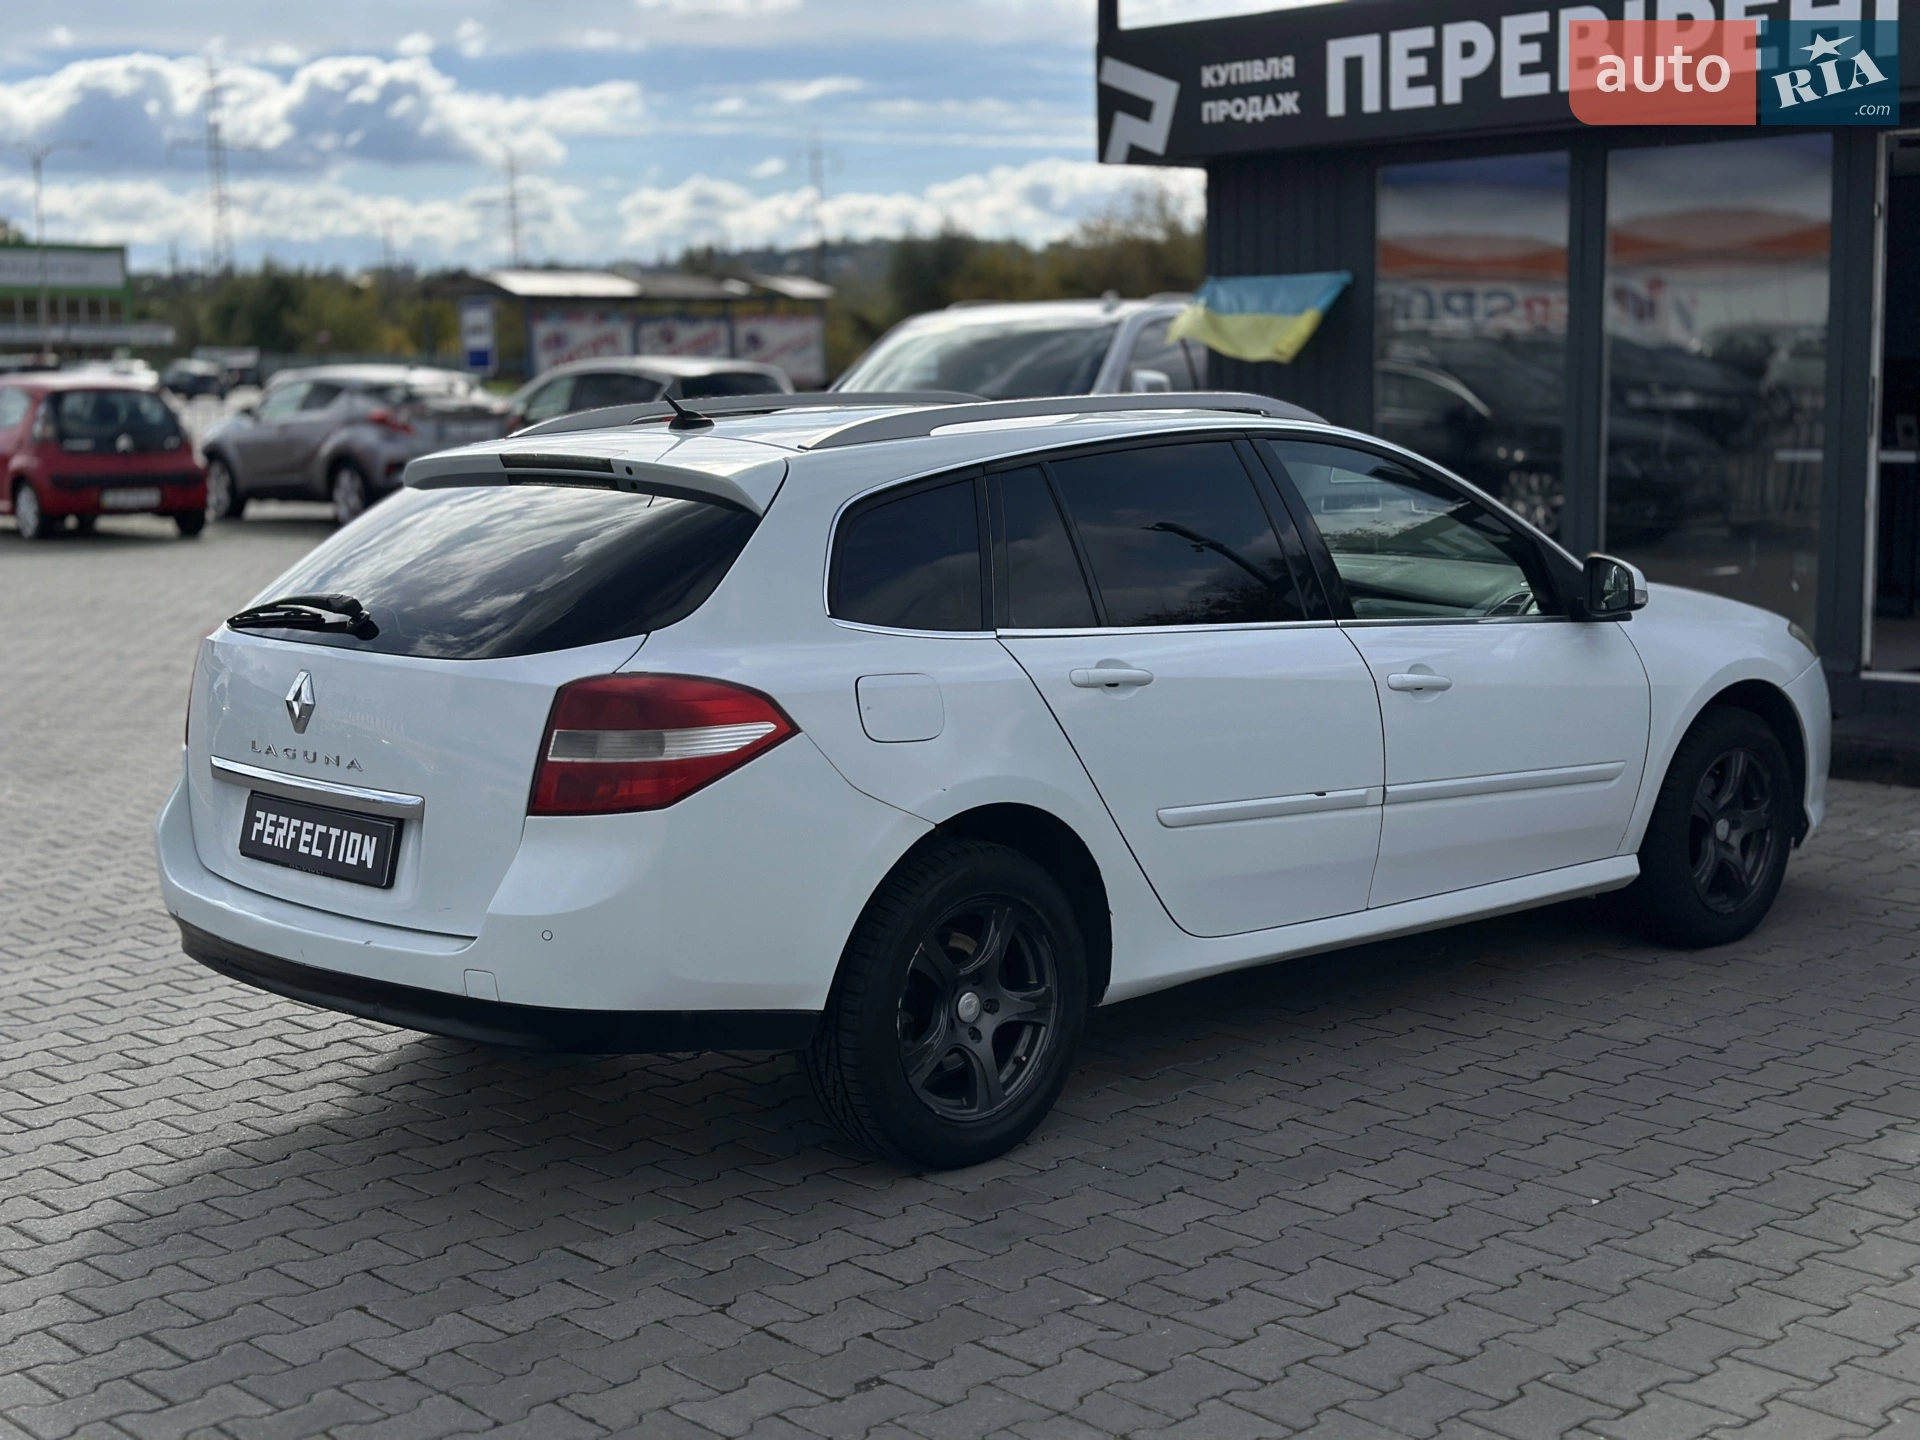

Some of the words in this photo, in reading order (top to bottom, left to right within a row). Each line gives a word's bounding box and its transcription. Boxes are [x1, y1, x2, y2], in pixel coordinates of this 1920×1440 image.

[1200, 54, 1295, 88] КУПІВЛЯ
[1201, 91, 1300, 124] ПРОДАЖ
[251, 739, 363, 772] LAGUNA
[251, 810, 378, 869] PERFECTION
